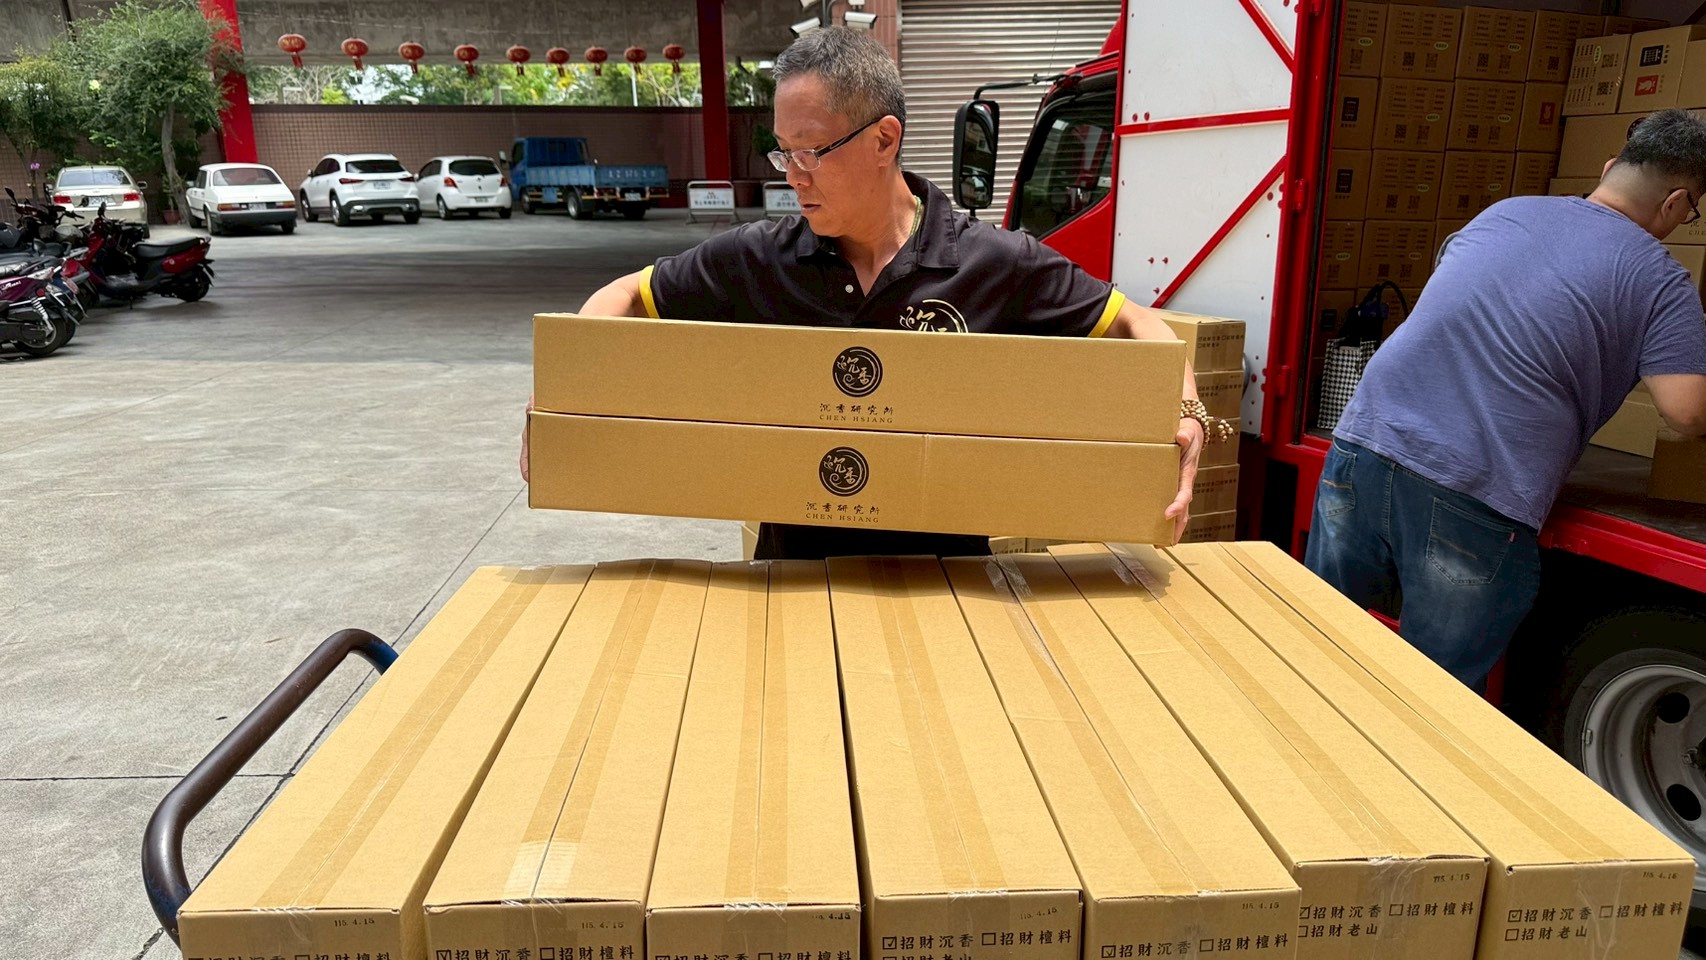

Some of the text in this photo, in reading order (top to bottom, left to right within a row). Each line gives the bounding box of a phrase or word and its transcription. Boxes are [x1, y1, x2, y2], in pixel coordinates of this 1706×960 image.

[819, 403, 894, 416] 沉香研究所
[852, 416, 893, 424] HSIANG
[805, 502, 880, 515] 沉香研究所
[1313, 902, 1473, 919] 招財沉香 招財檀料
[1524, 901, 1683, 922] 招財沉香 招財檀料
[1311, 923, 1378, 938] 招財老山
[1521, 925, 1588, 941] 招財老山
[900, 929, 1072, 950] 招財沉香 招財檀料
[1119, 933, 1289, 958] 招財沉香 招財檀料
[559, 945, 634, 960] 招財檀料
